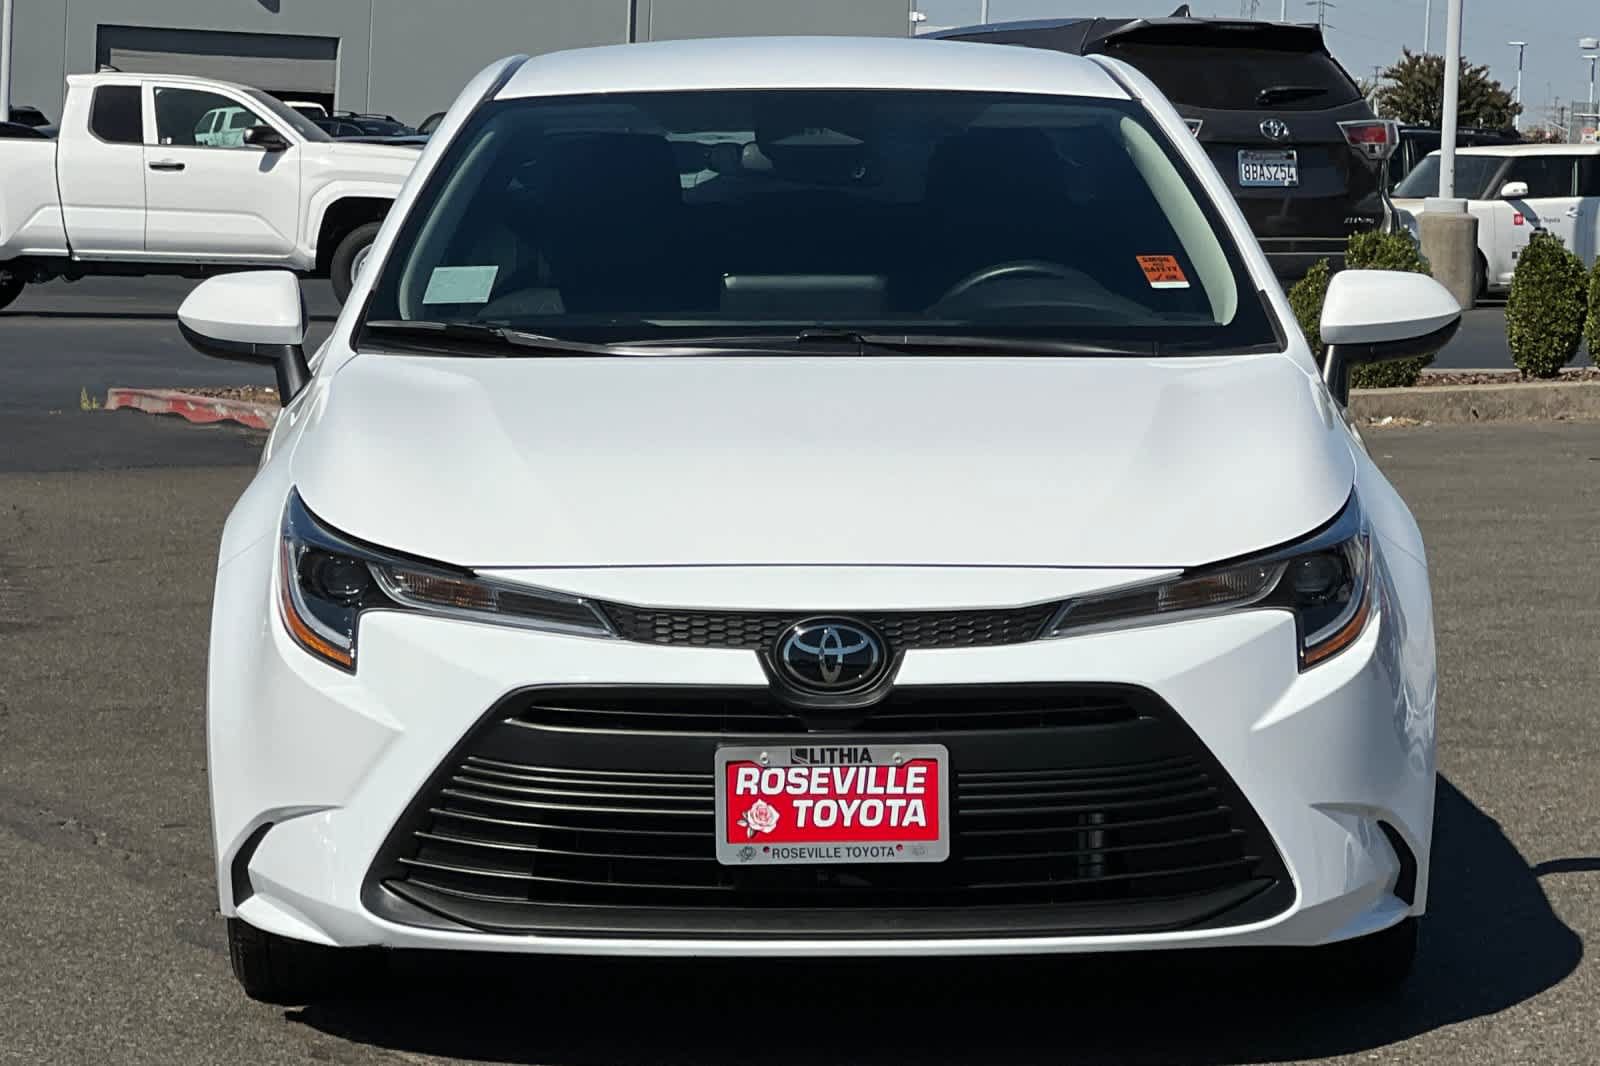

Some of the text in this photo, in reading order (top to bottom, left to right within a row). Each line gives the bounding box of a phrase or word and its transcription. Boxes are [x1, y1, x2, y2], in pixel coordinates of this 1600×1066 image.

[807, 747, 873, 764] LITHIA
[735, 766, 928, 796] ROSEVILLE
[792, 799, 927, 828] TOYOTA
[771, 846, 895, 860] ROSEVILLE TOYOTA
